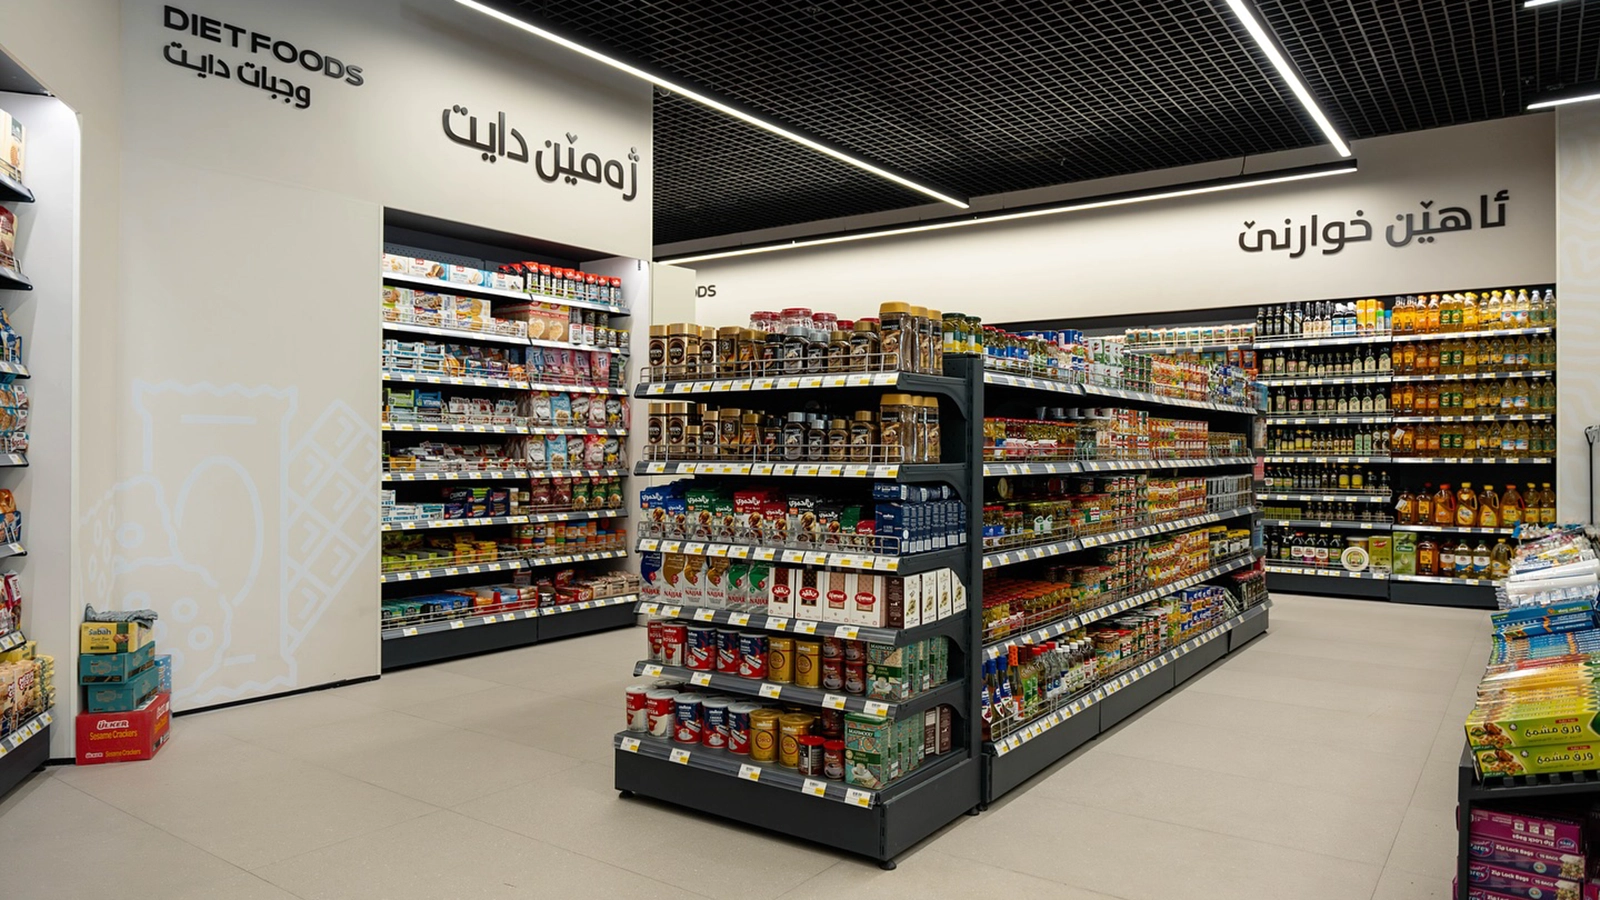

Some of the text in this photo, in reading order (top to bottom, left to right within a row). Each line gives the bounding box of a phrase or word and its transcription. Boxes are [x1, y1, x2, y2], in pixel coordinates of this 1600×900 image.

[164, 5, 364, 86] DIET FOODS
[163, 42, 310, 109] وجبات دايت
[695, 285, 716, 298] DS
[98, 720, 128, 729] ÜLKER
[89, 729, 138, 741] Sesame Crackers
[1495, 844, 1506, 853] Zip
[1520, 849, 1534, 857] Bags
[1491, 869, 1529, 883] Zip Lock Bags
